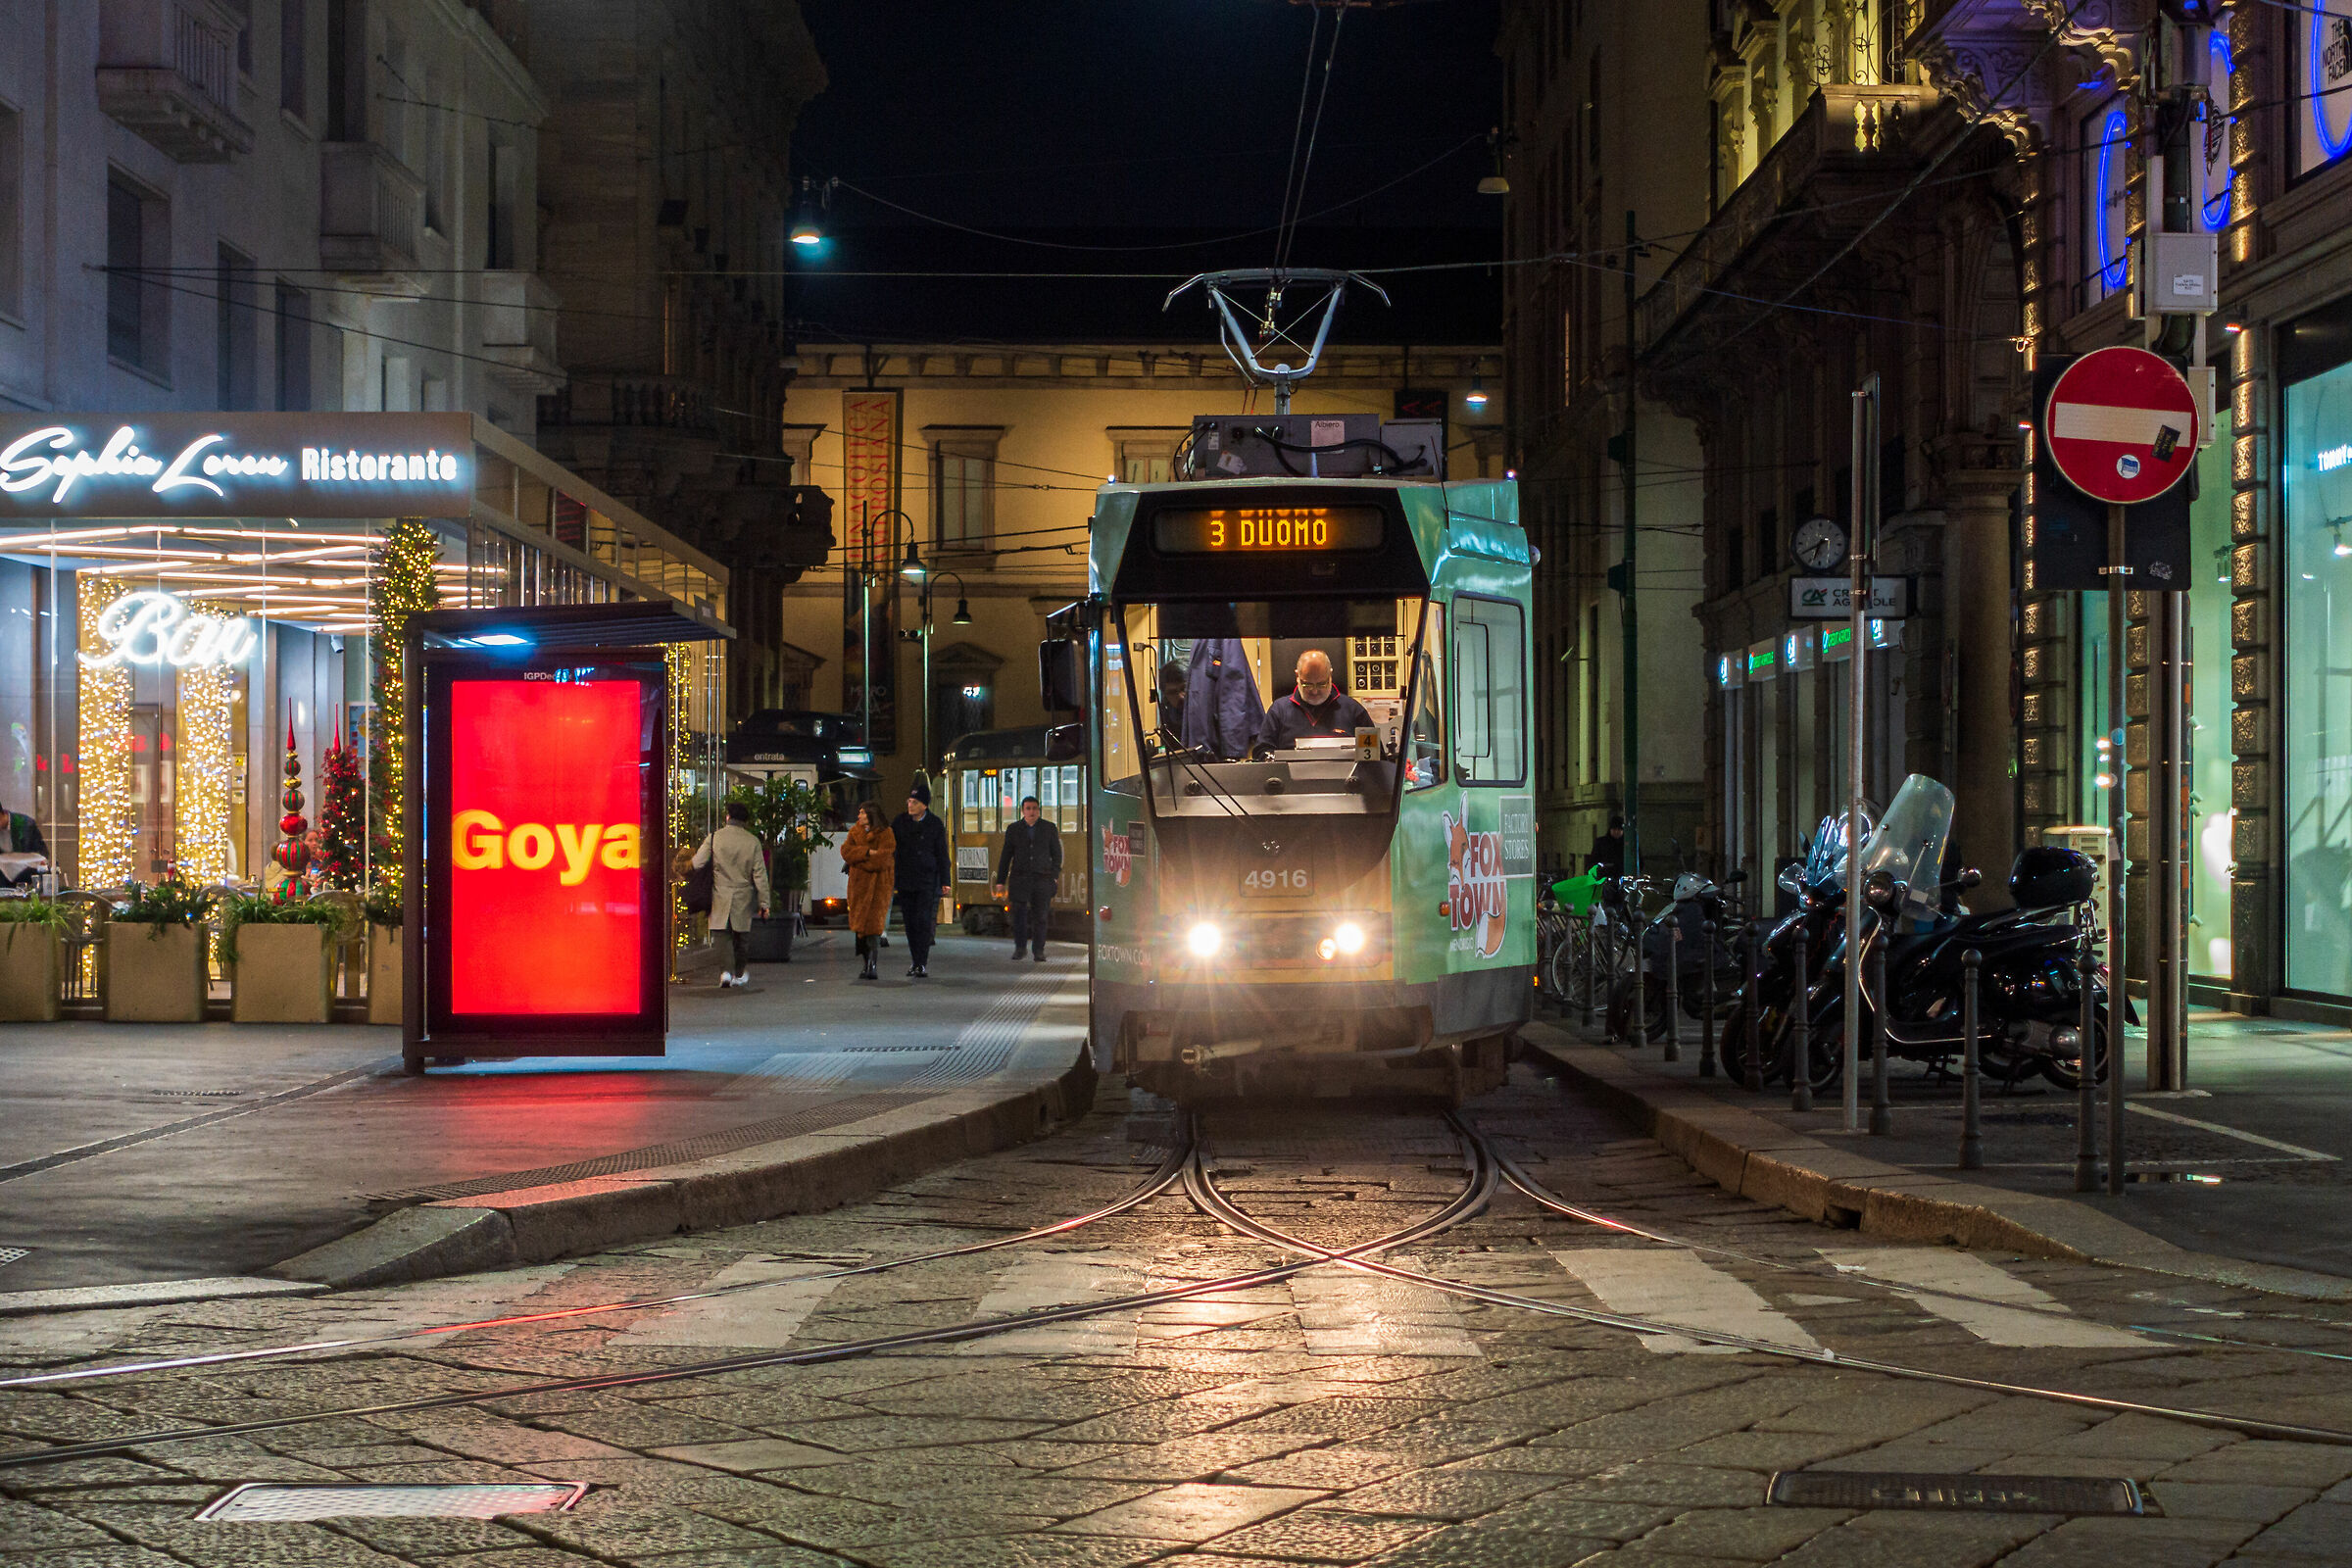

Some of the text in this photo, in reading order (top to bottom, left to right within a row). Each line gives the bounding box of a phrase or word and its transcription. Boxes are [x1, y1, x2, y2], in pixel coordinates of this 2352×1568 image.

[0, 425, 163, 504] Sophia
[302, 447, 458, 481] Ristorante
[1210, 518, 1327, 546] 3 DUOMO
[74, 592, 258, 667] Bar
[1363, 735, 1372, 747] 4
[754, 752, 785, 761] entrata
[1363, 748, 1372, 760] 3
[1504, 813, 1529, 834] FACTORY
[452, 809, 640, 886] Goya
[1112, 834, 1131, 856] FOX
[1469, 832, 1504, 879] FOX
[1504, 839, 1530, 860] STORES
[1103, 855, 1132, 873] TOWN
[1245, 869, 1307, 889] 4916
[1448, 880, 1507, 931] TOWN
